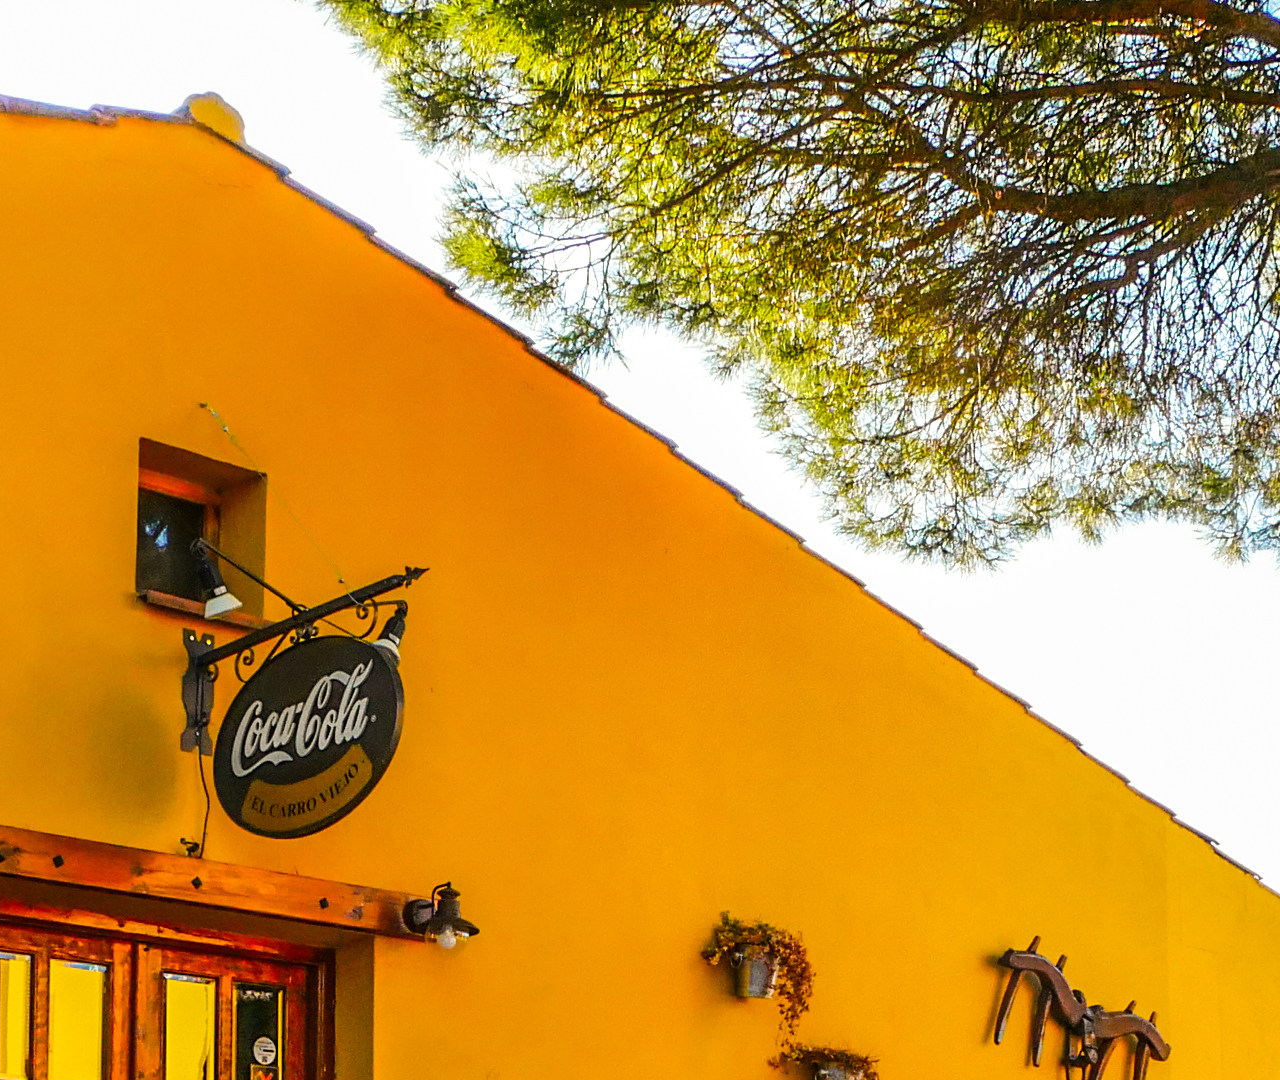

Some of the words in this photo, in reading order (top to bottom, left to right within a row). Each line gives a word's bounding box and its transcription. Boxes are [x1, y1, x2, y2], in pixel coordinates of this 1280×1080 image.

[231, 658, 374, 778] Coca-Cola
[251, 796, 266, 815] EL
[269, 797, 317, 818] CARRO
[319, 763, 360, 803] VIEJO
